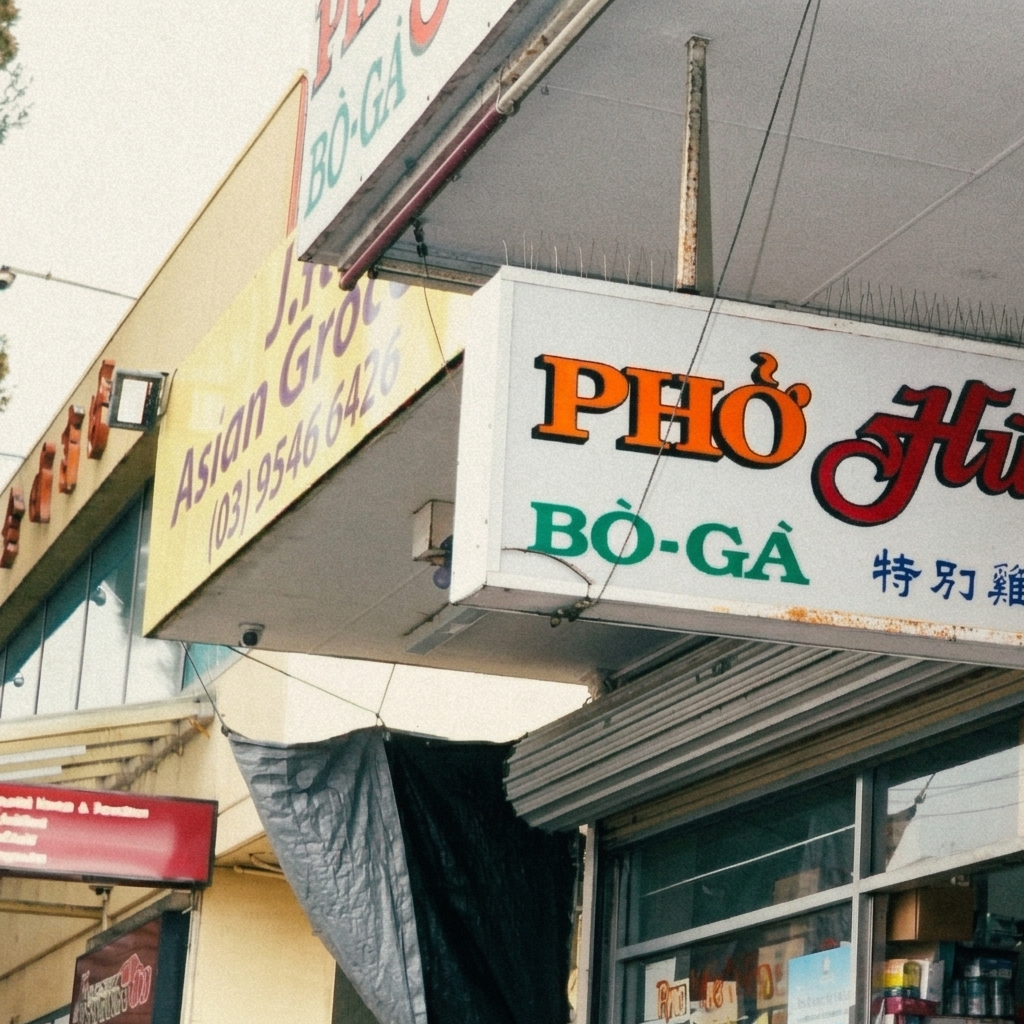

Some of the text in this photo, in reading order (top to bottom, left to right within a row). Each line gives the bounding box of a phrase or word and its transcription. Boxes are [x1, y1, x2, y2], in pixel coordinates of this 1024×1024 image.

[171, 381, 268, 529] Asian
[279, 280, 410, 407] Groc
[208, 324, 401, 565] (03) 9546 6426
[531, 352, 812, 469] PHỞ
[527, 499, 810, 586] BÒ-GÀ
